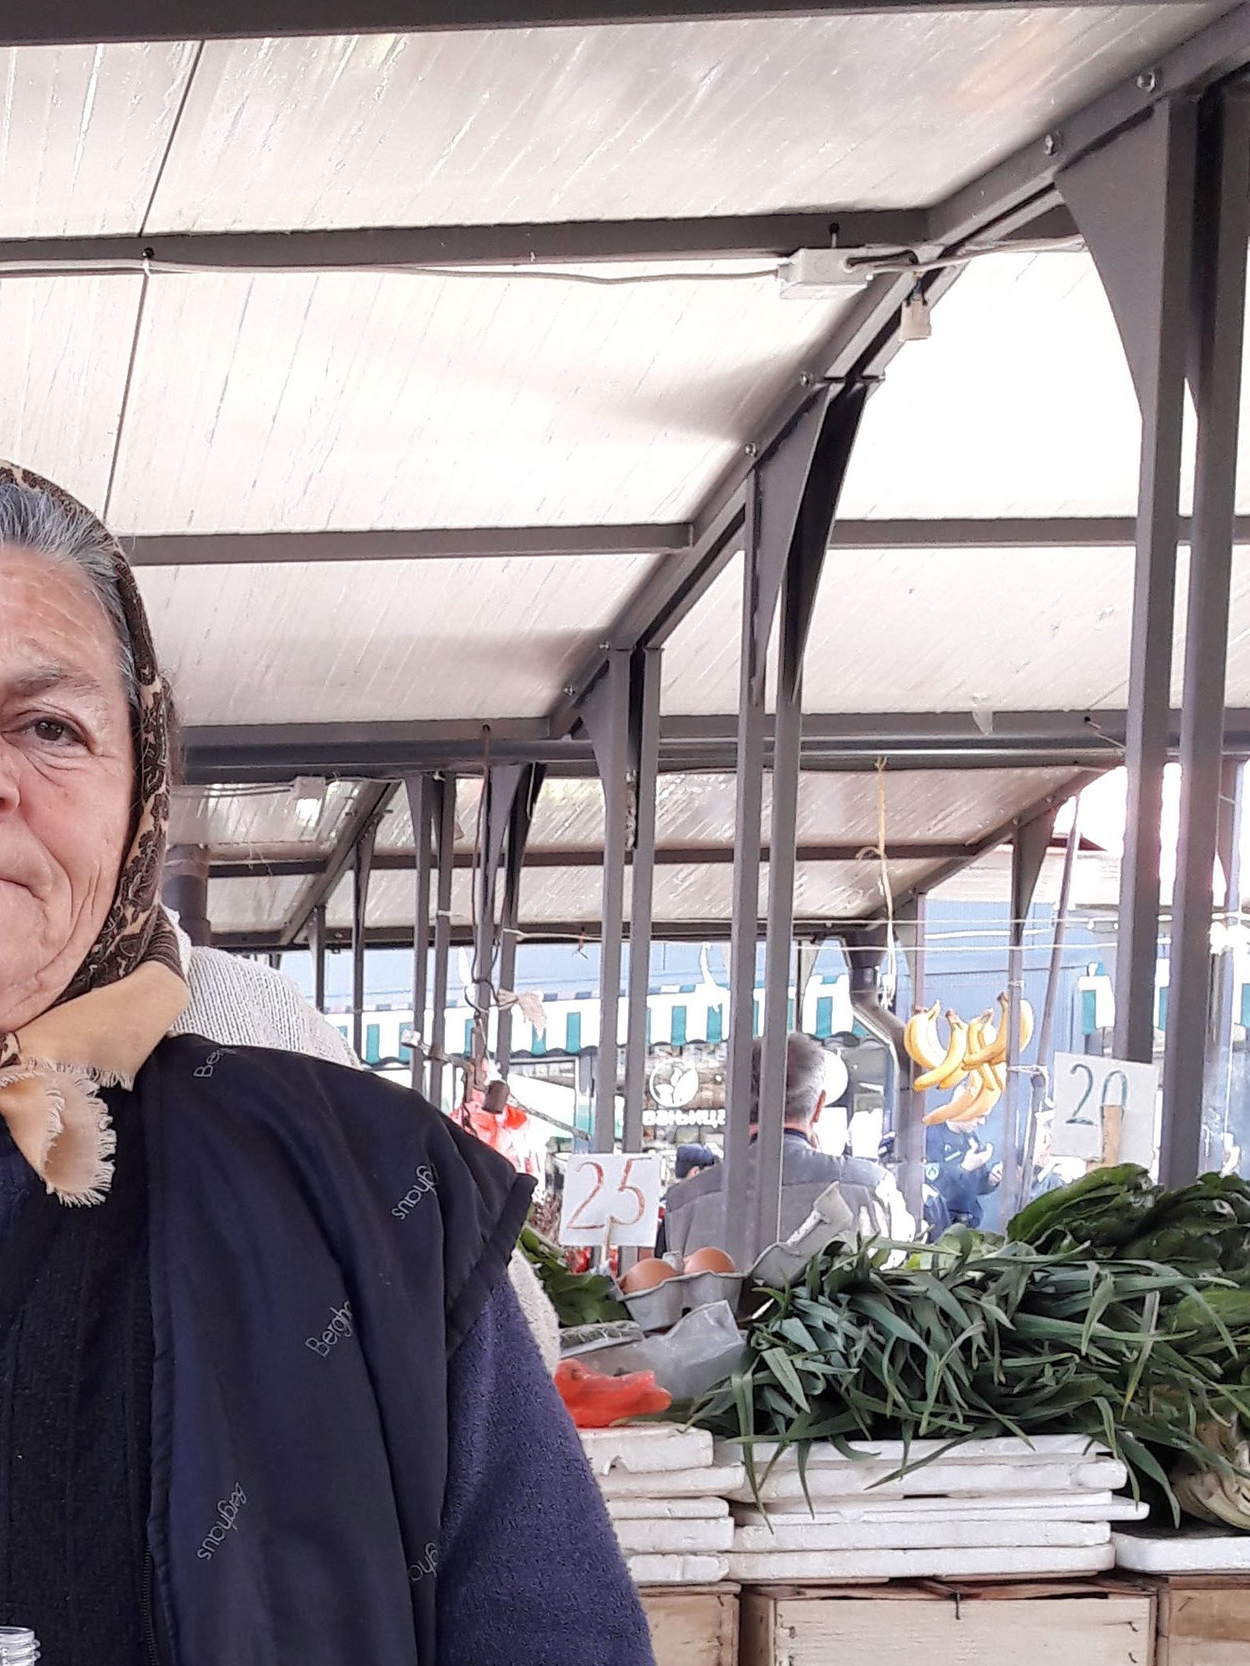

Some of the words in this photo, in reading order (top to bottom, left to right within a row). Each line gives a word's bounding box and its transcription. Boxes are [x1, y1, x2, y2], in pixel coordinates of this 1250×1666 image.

[1066, 1063, 1128, 1126] 20
[391, 1164, 438, 1221] ghaus
[567, 1157, 653, 1230] 25
[304, 1300, 353, 1358] Bergh
[196, 1482, 247, 1561] Berghaus
